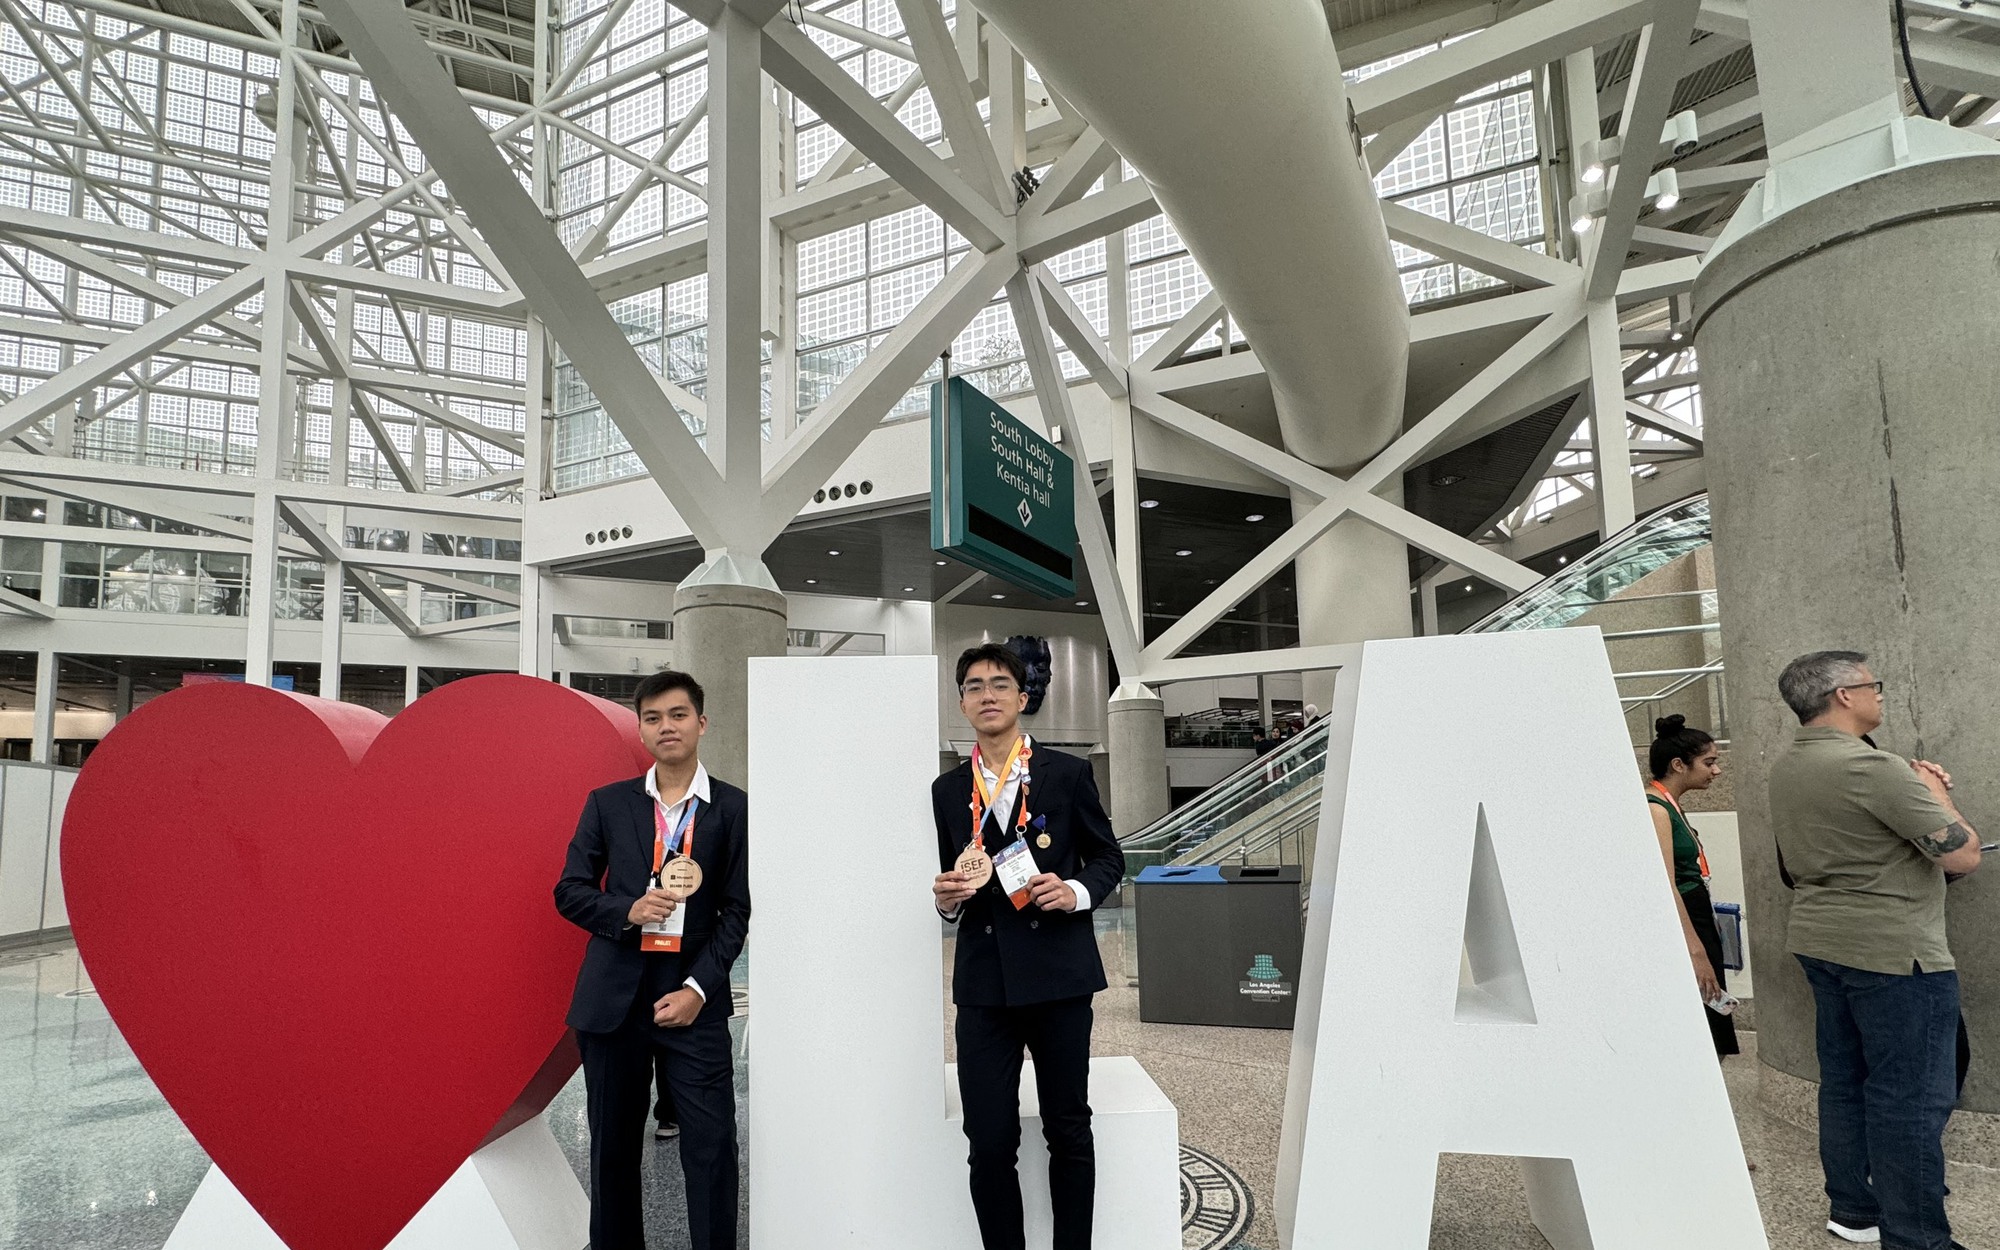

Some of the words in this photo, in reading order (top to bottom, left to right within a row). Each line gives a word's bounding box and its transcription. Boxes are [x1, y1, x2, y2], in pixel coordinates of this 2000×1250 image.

[990, 411, 1022, 447] South
[1025, 436, 1054, 472] Lobby
[991, 435, 1023, 469] South
[1026, 458, 1044, 482] Hall
[1047, 473, 1054, 490] &
[996, 461, 1030, 496] Kentia
[1033, 483, 1050, 508] hall
[960, 858, 984, 874] ISEF
[1259, 981, 1280, 989] Angeles
